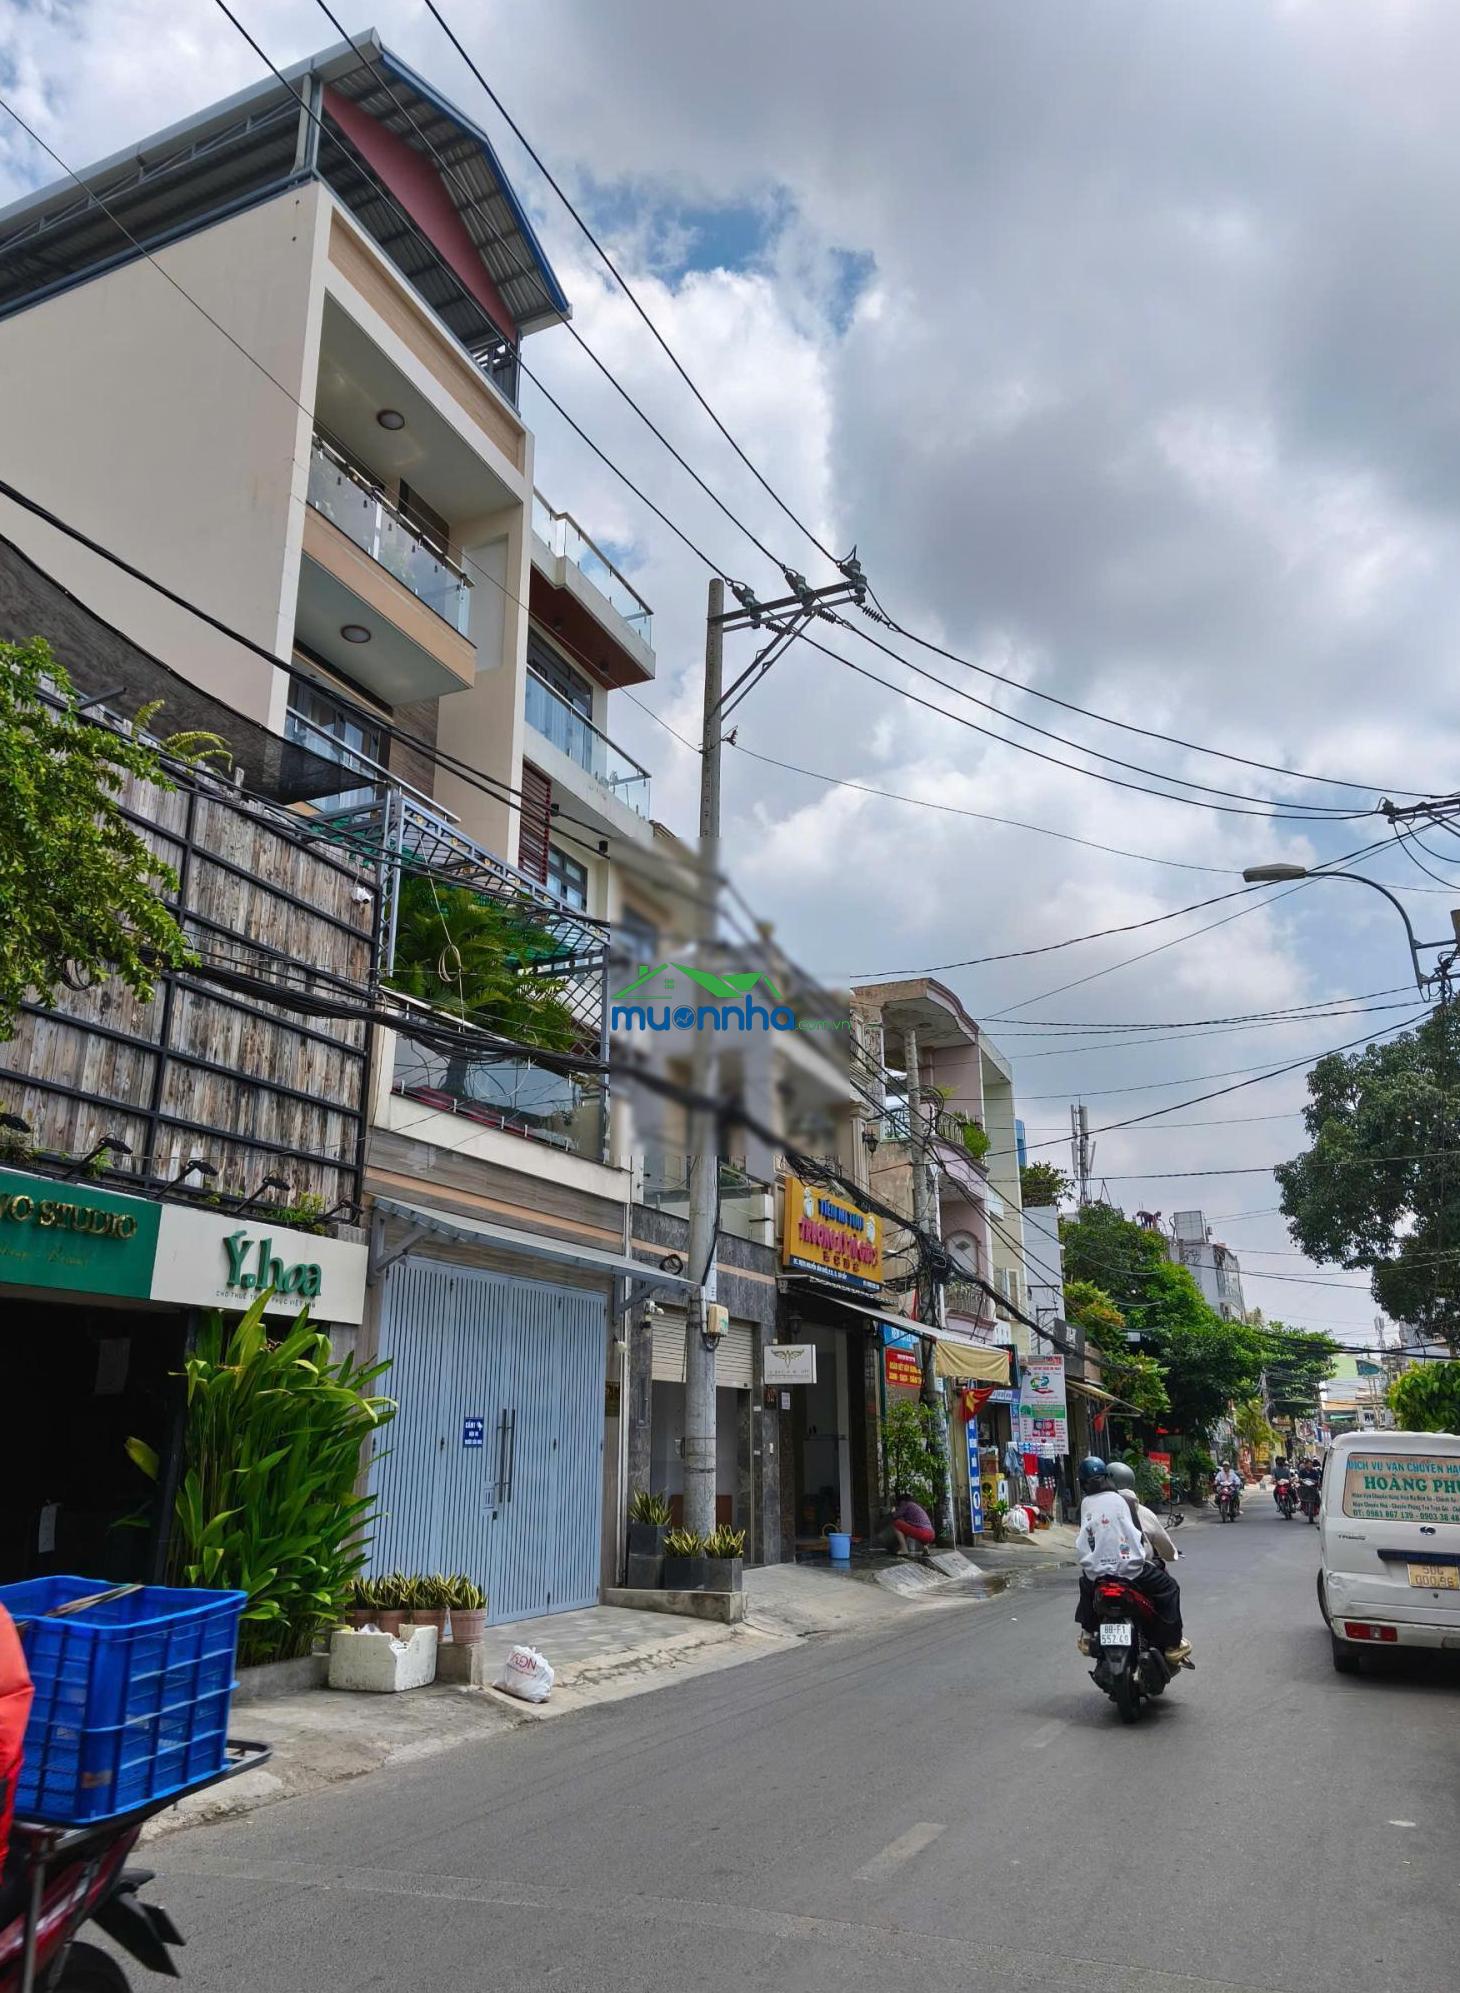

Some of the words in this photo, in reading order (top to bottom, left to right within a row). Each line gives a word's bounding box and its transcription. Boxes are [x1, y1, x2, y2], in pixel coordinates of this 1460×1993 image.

[0, 1192, 34, 1222] O
[40, 1200, 138, 1239] STUDIO
[222, 1230, 322, 1297] Ý.hoa
[1364, 1474, 1427, 1491] HOÀNG
